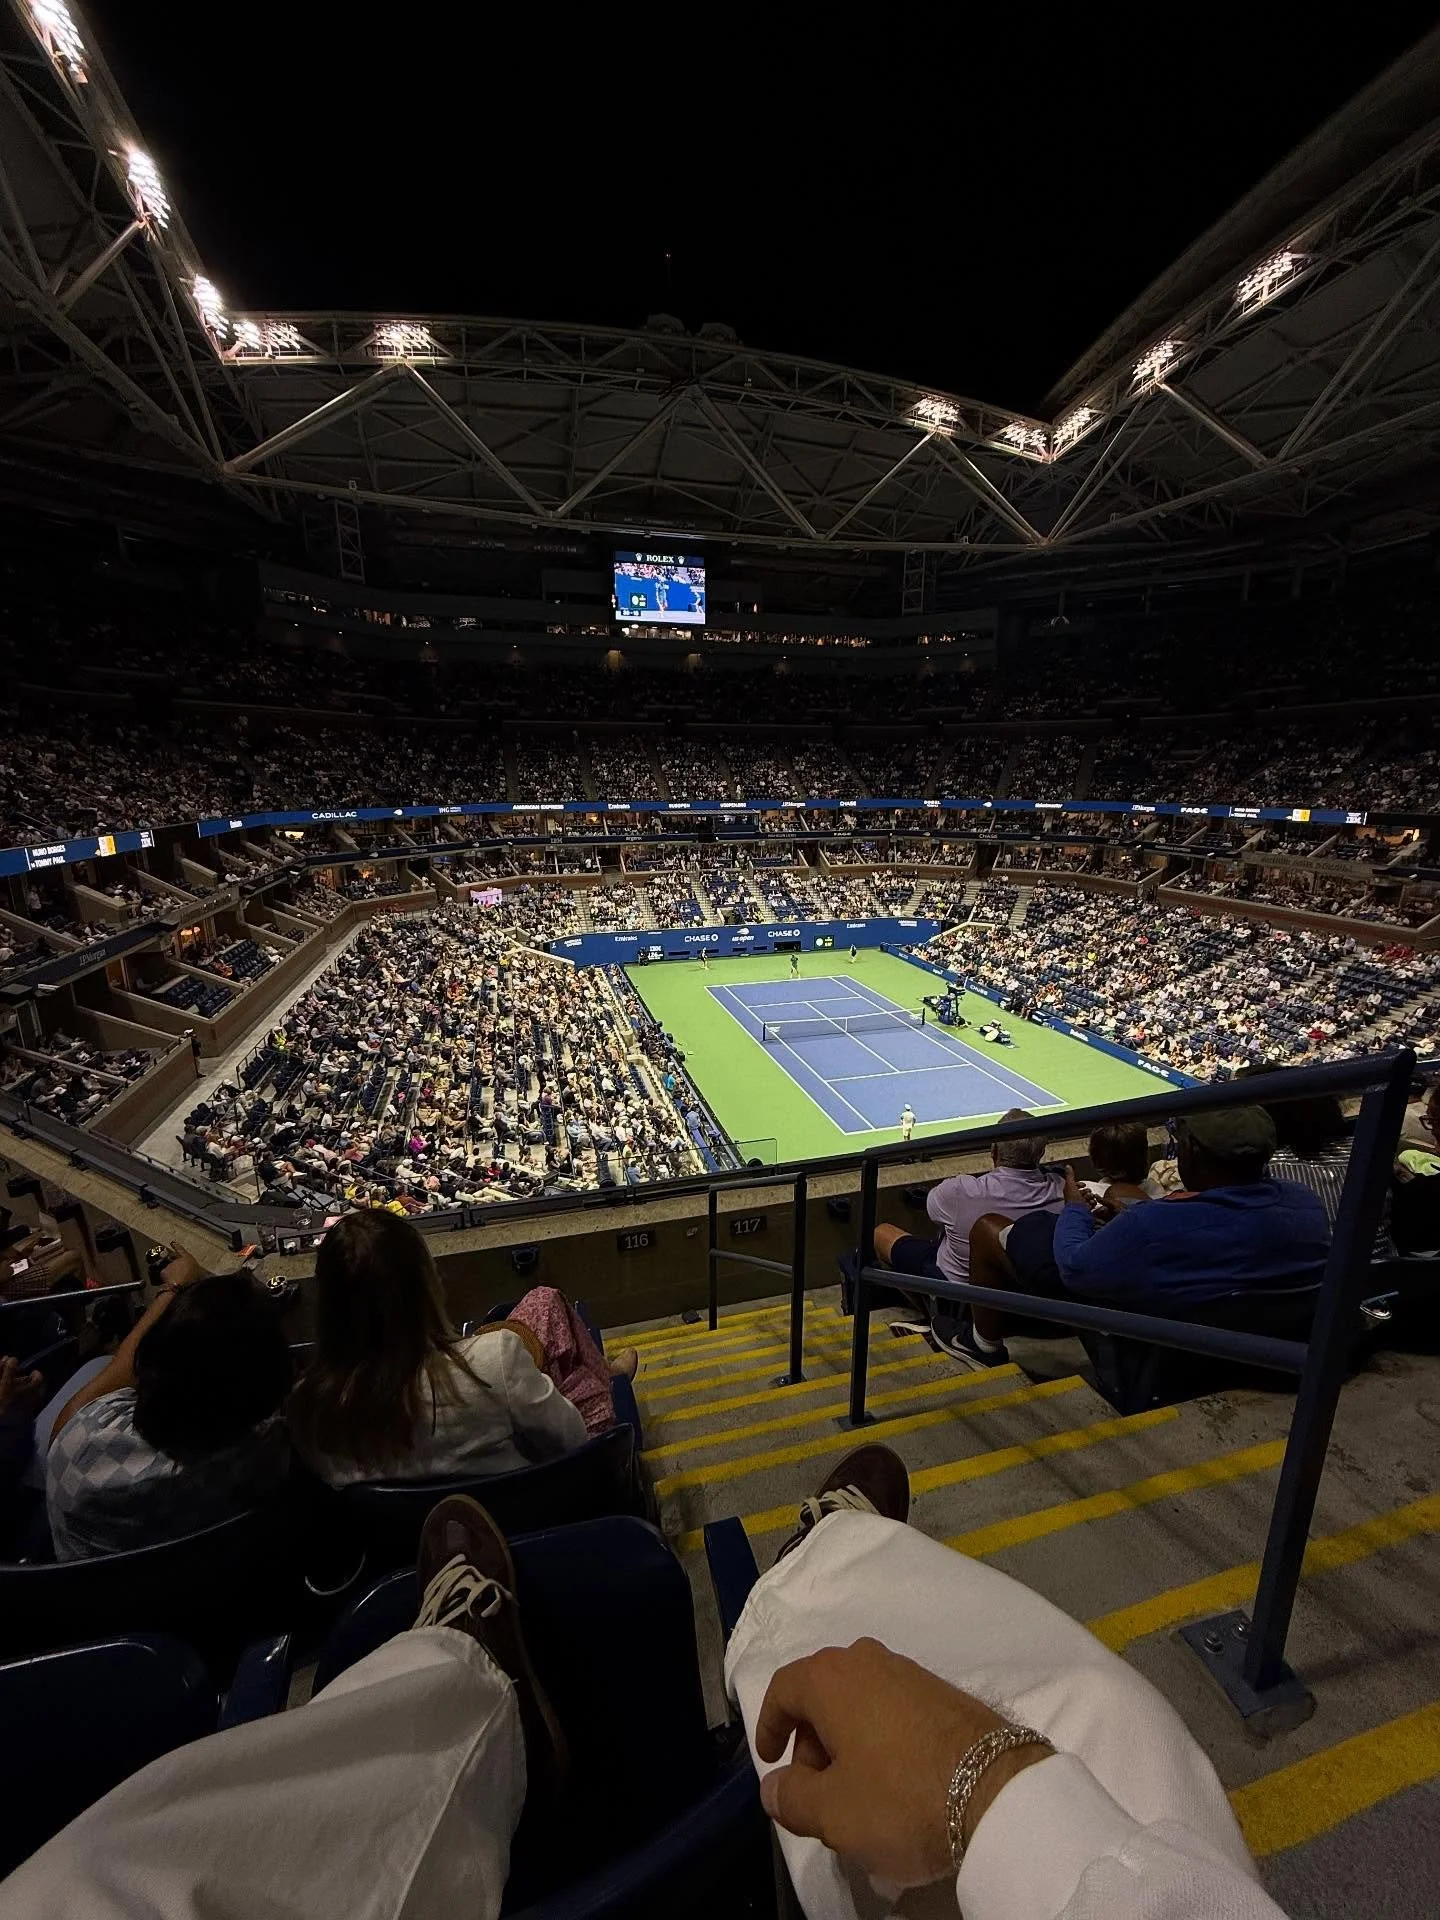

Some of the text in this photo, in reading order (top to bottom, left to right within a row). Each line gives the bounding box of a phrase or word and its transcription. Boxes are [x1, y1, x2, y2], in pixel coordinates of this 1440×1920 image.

[646, 554, 674, 563] ROLEX
[312, 811, 357, 819] CADILLAC
[684, 934, 710, 942] CHASE
[768, 930, 792, 938] CHASE
[1137, 1059, 1170, 1078] FAGE
[734, 1217, 761, 1235] 117
[625, 1233, 649, 1249] 116
